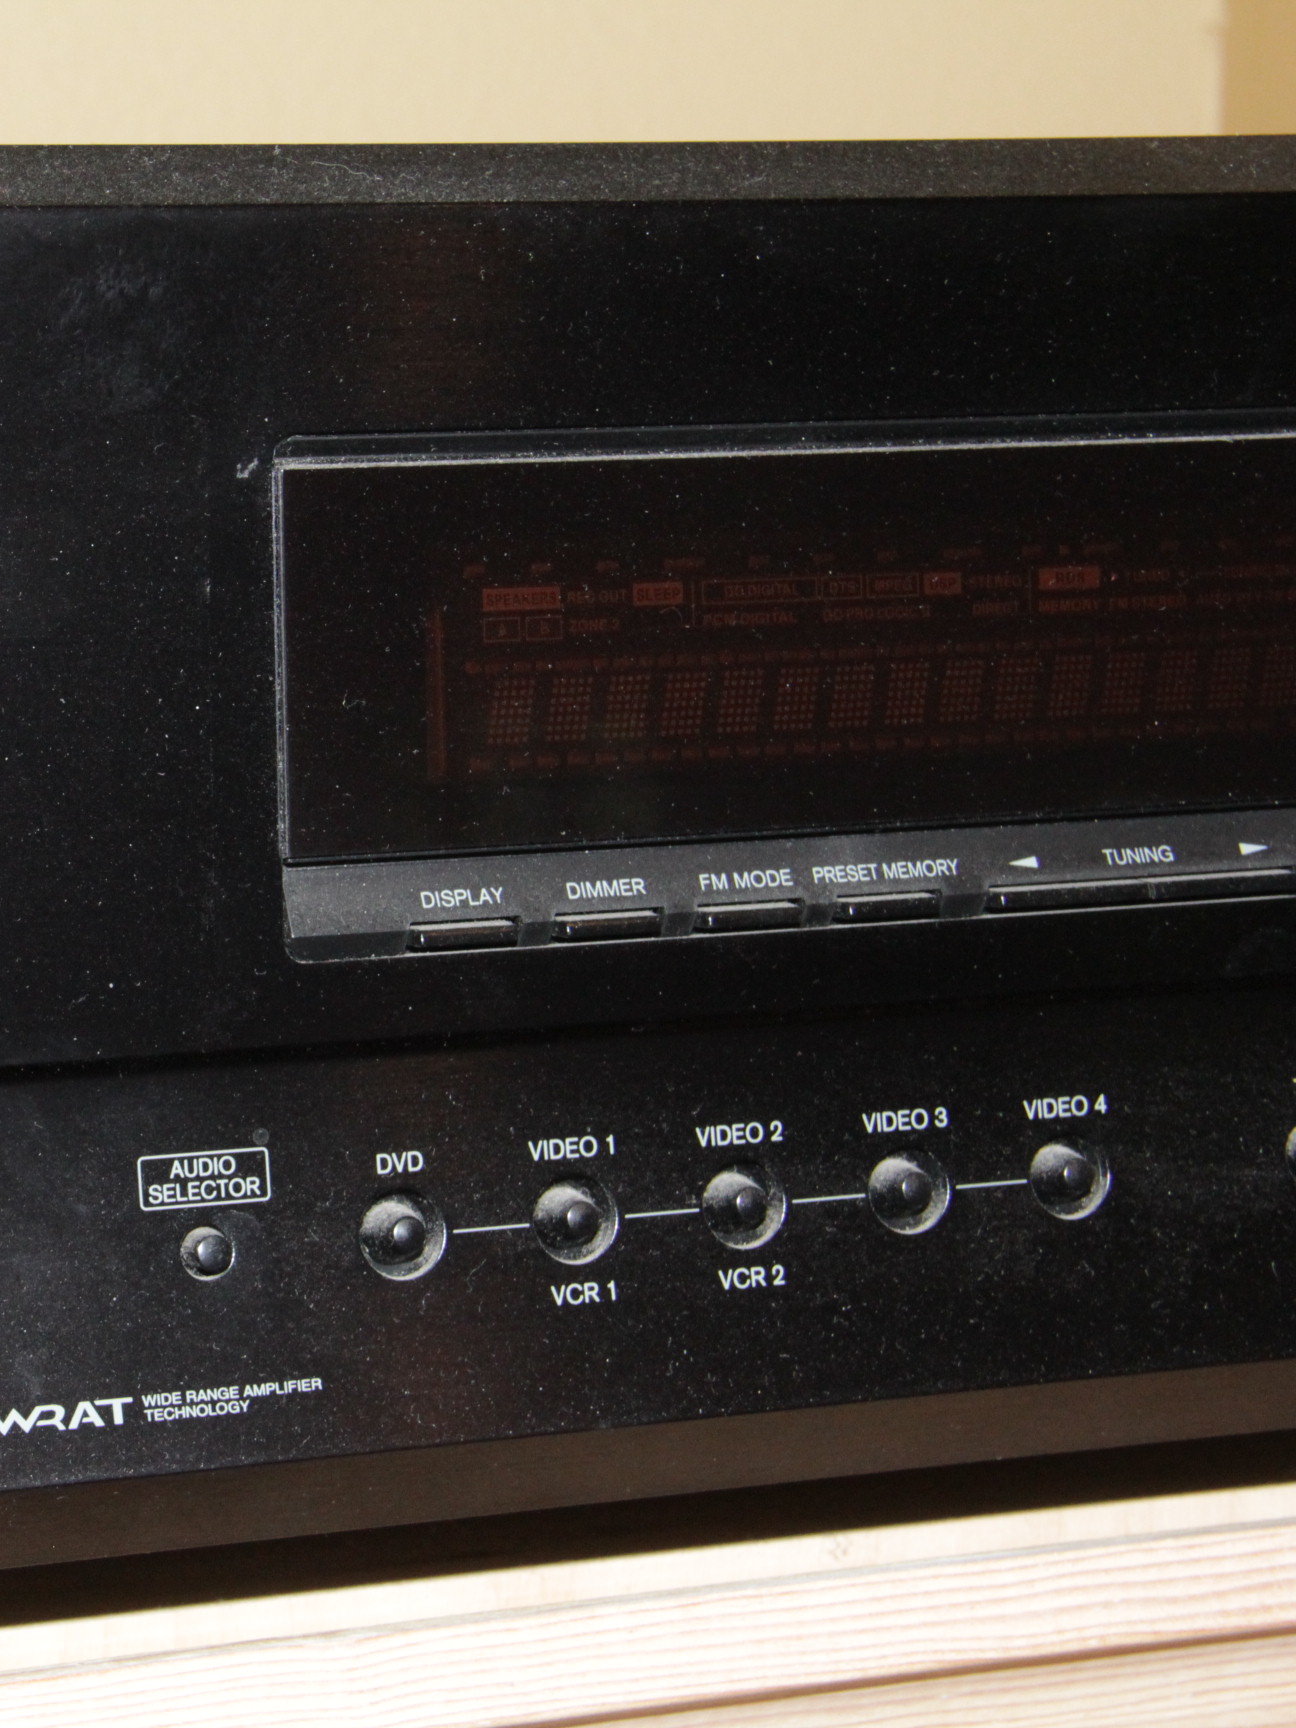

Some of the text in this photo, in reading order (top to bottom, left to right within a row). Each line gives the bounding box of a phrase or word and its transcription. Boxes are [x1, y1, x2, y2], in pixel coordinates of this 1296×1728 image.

[485, 588, 560, 608] SPEAKERS
[635, 587, 681, 603] SLEEP
[1102, 845, 1175, 866] TUNING
[698, 868, 794, 892] FM MODE
[812, 858, 960, 884] PRESET MEMORY
[420, 887, 504, 909] DISPLAY
[565, 878, 647, 900] DIMMER
[1023, 1093, 1108, 1121] VIDEO 4
[862, 1107, 949, 1135] VIDEO 3
[695, 1120, 784, 1149] VIDEO 2
[528, 1133, 617, 1162] VIDEO 1
[169, 1155, 237, 1180] AUDIO
[375, 1150, 425, 1175] DVD
[148, 1177, 261, 1205] SELECTOR
[718, 1264, 786, 1291] VCR 2
[551, 1280, 618, 1307] VCR 1
[141, 1377, 323, 1408] WIDE RANGE AMPLIFIER
[144, 1399, 250, 1423] TECHNOLOGY
